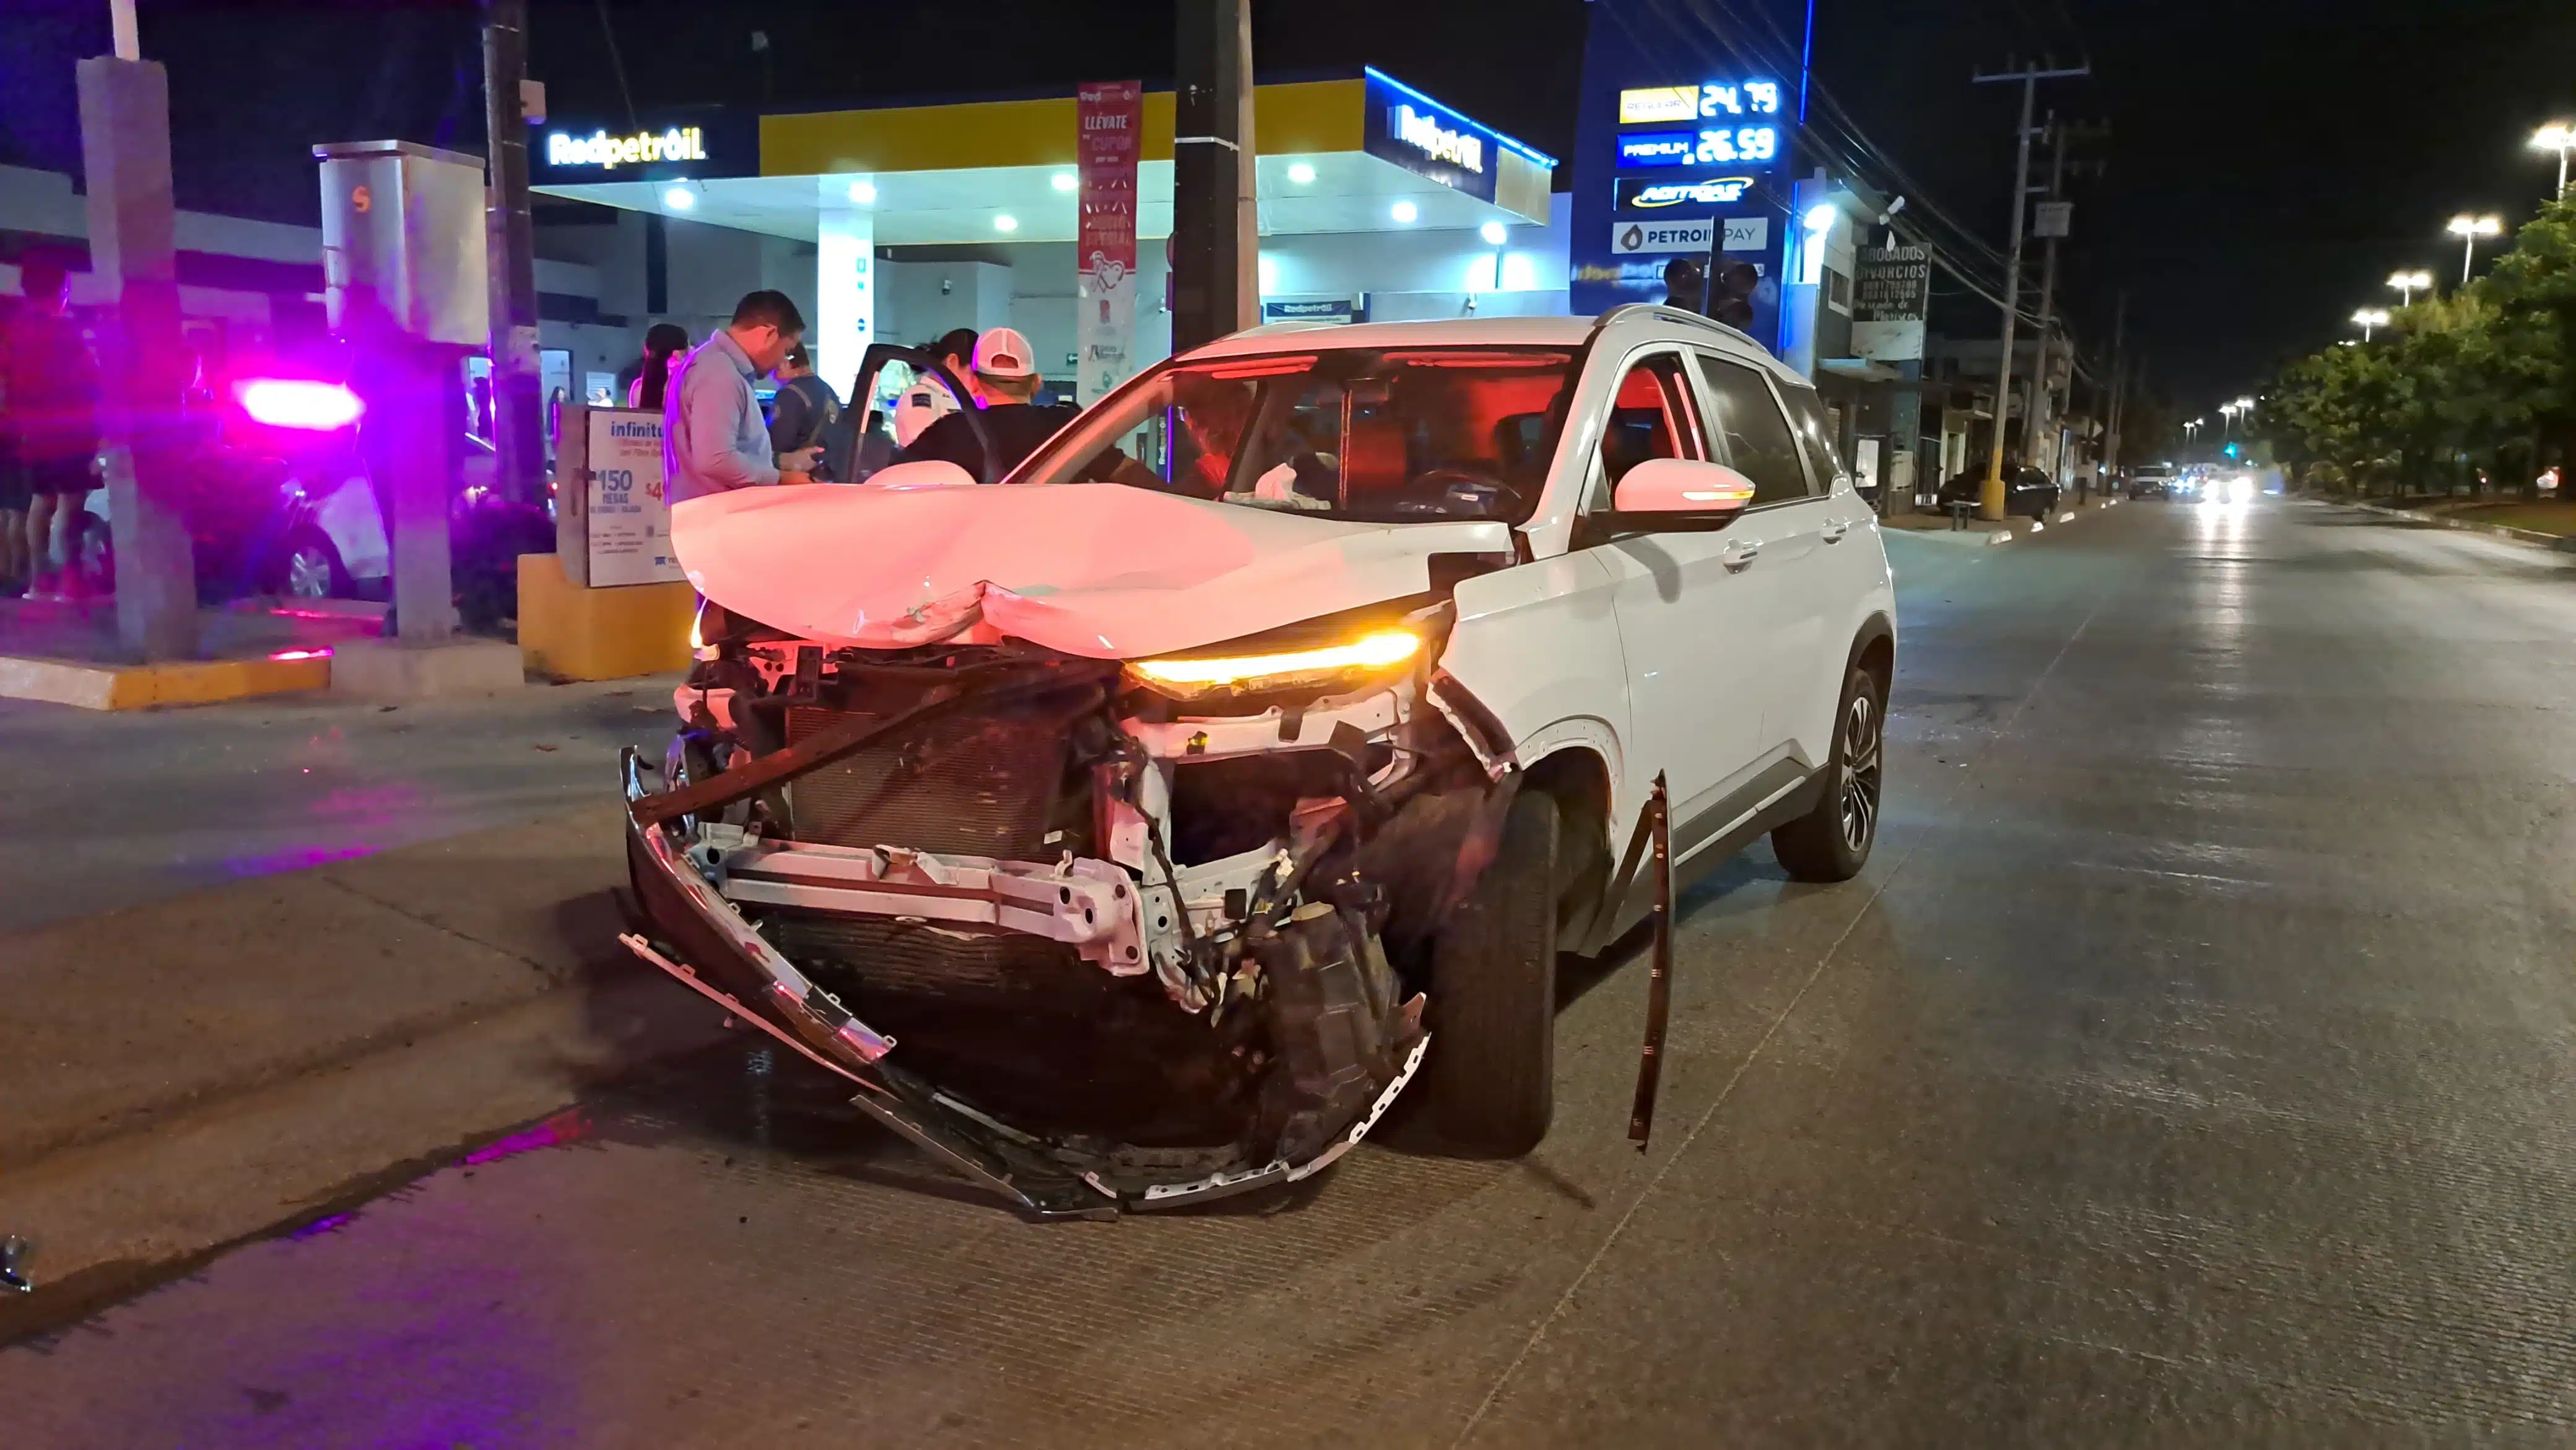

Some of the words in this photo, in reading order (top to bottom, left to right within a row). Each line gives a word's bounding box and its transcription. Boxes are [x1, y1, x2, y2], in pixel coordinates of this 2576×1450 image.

[1696, 128, 1775, 162] 26.59
[1723, 227, 1757, 241] PAY
[611, 421, 664, 438] infinitu
[598, 470, 633, 491] 150
